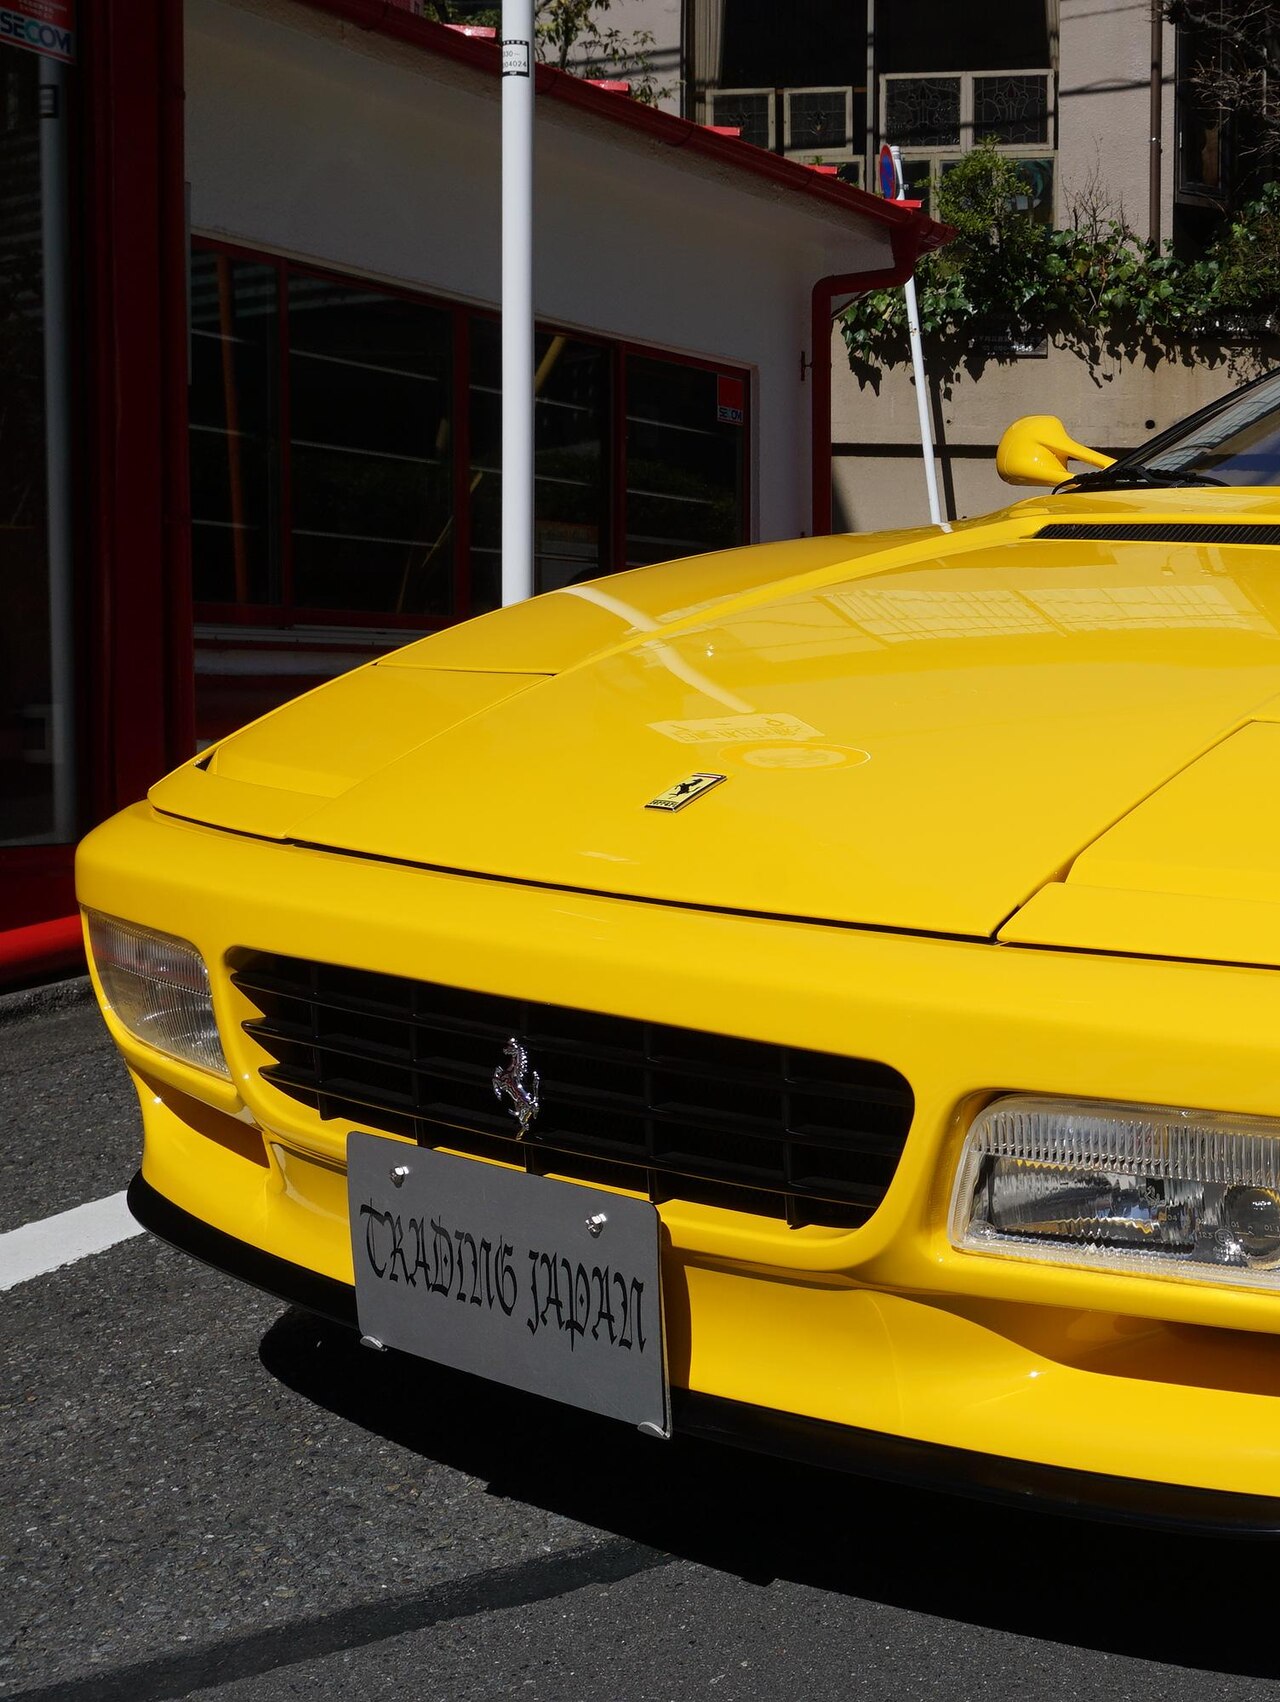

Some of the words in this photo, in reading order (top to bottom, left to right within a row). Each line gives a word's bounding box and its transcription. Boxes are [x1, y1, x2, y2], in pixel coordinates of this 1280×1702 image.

[0, 11, 72, 54] SECOM
[719, 407, 742, 421] SECOM
[360, 1197, 518, 1317] TRADING
[527, 1249, 647, 1354] JAPAN
